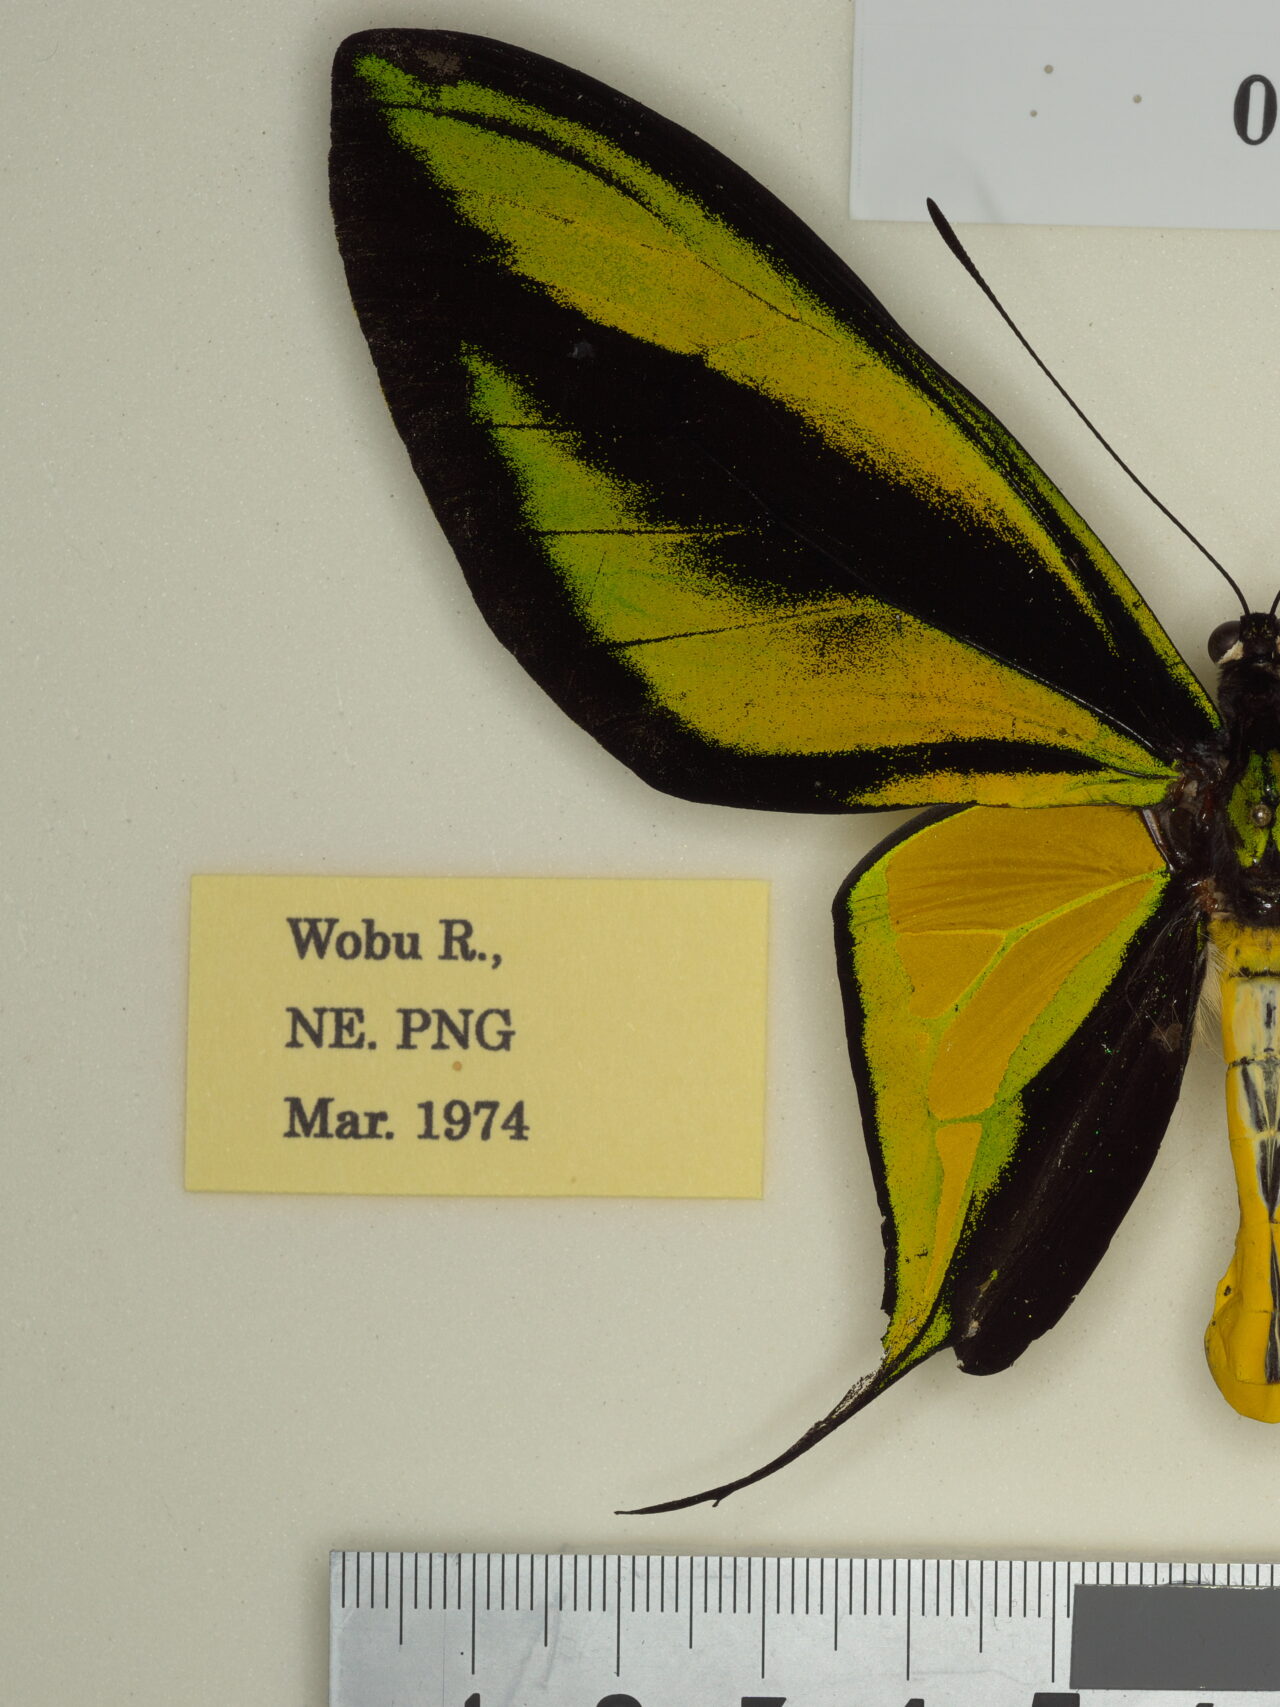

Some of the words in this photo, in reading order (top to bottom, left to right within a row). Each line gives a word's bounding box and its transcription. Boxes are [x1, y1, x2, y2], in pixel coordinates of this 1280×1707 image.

[286, 917, 423, 961] Wobu
[438, 918, 503, 970] R.,
[284, 1006, 377, 1050] NE.
[396, 1007, 516, 1052] PNG
[283, 1096, 395, 1141] Mar.
[417, 1100, 530, 1142] 1974
